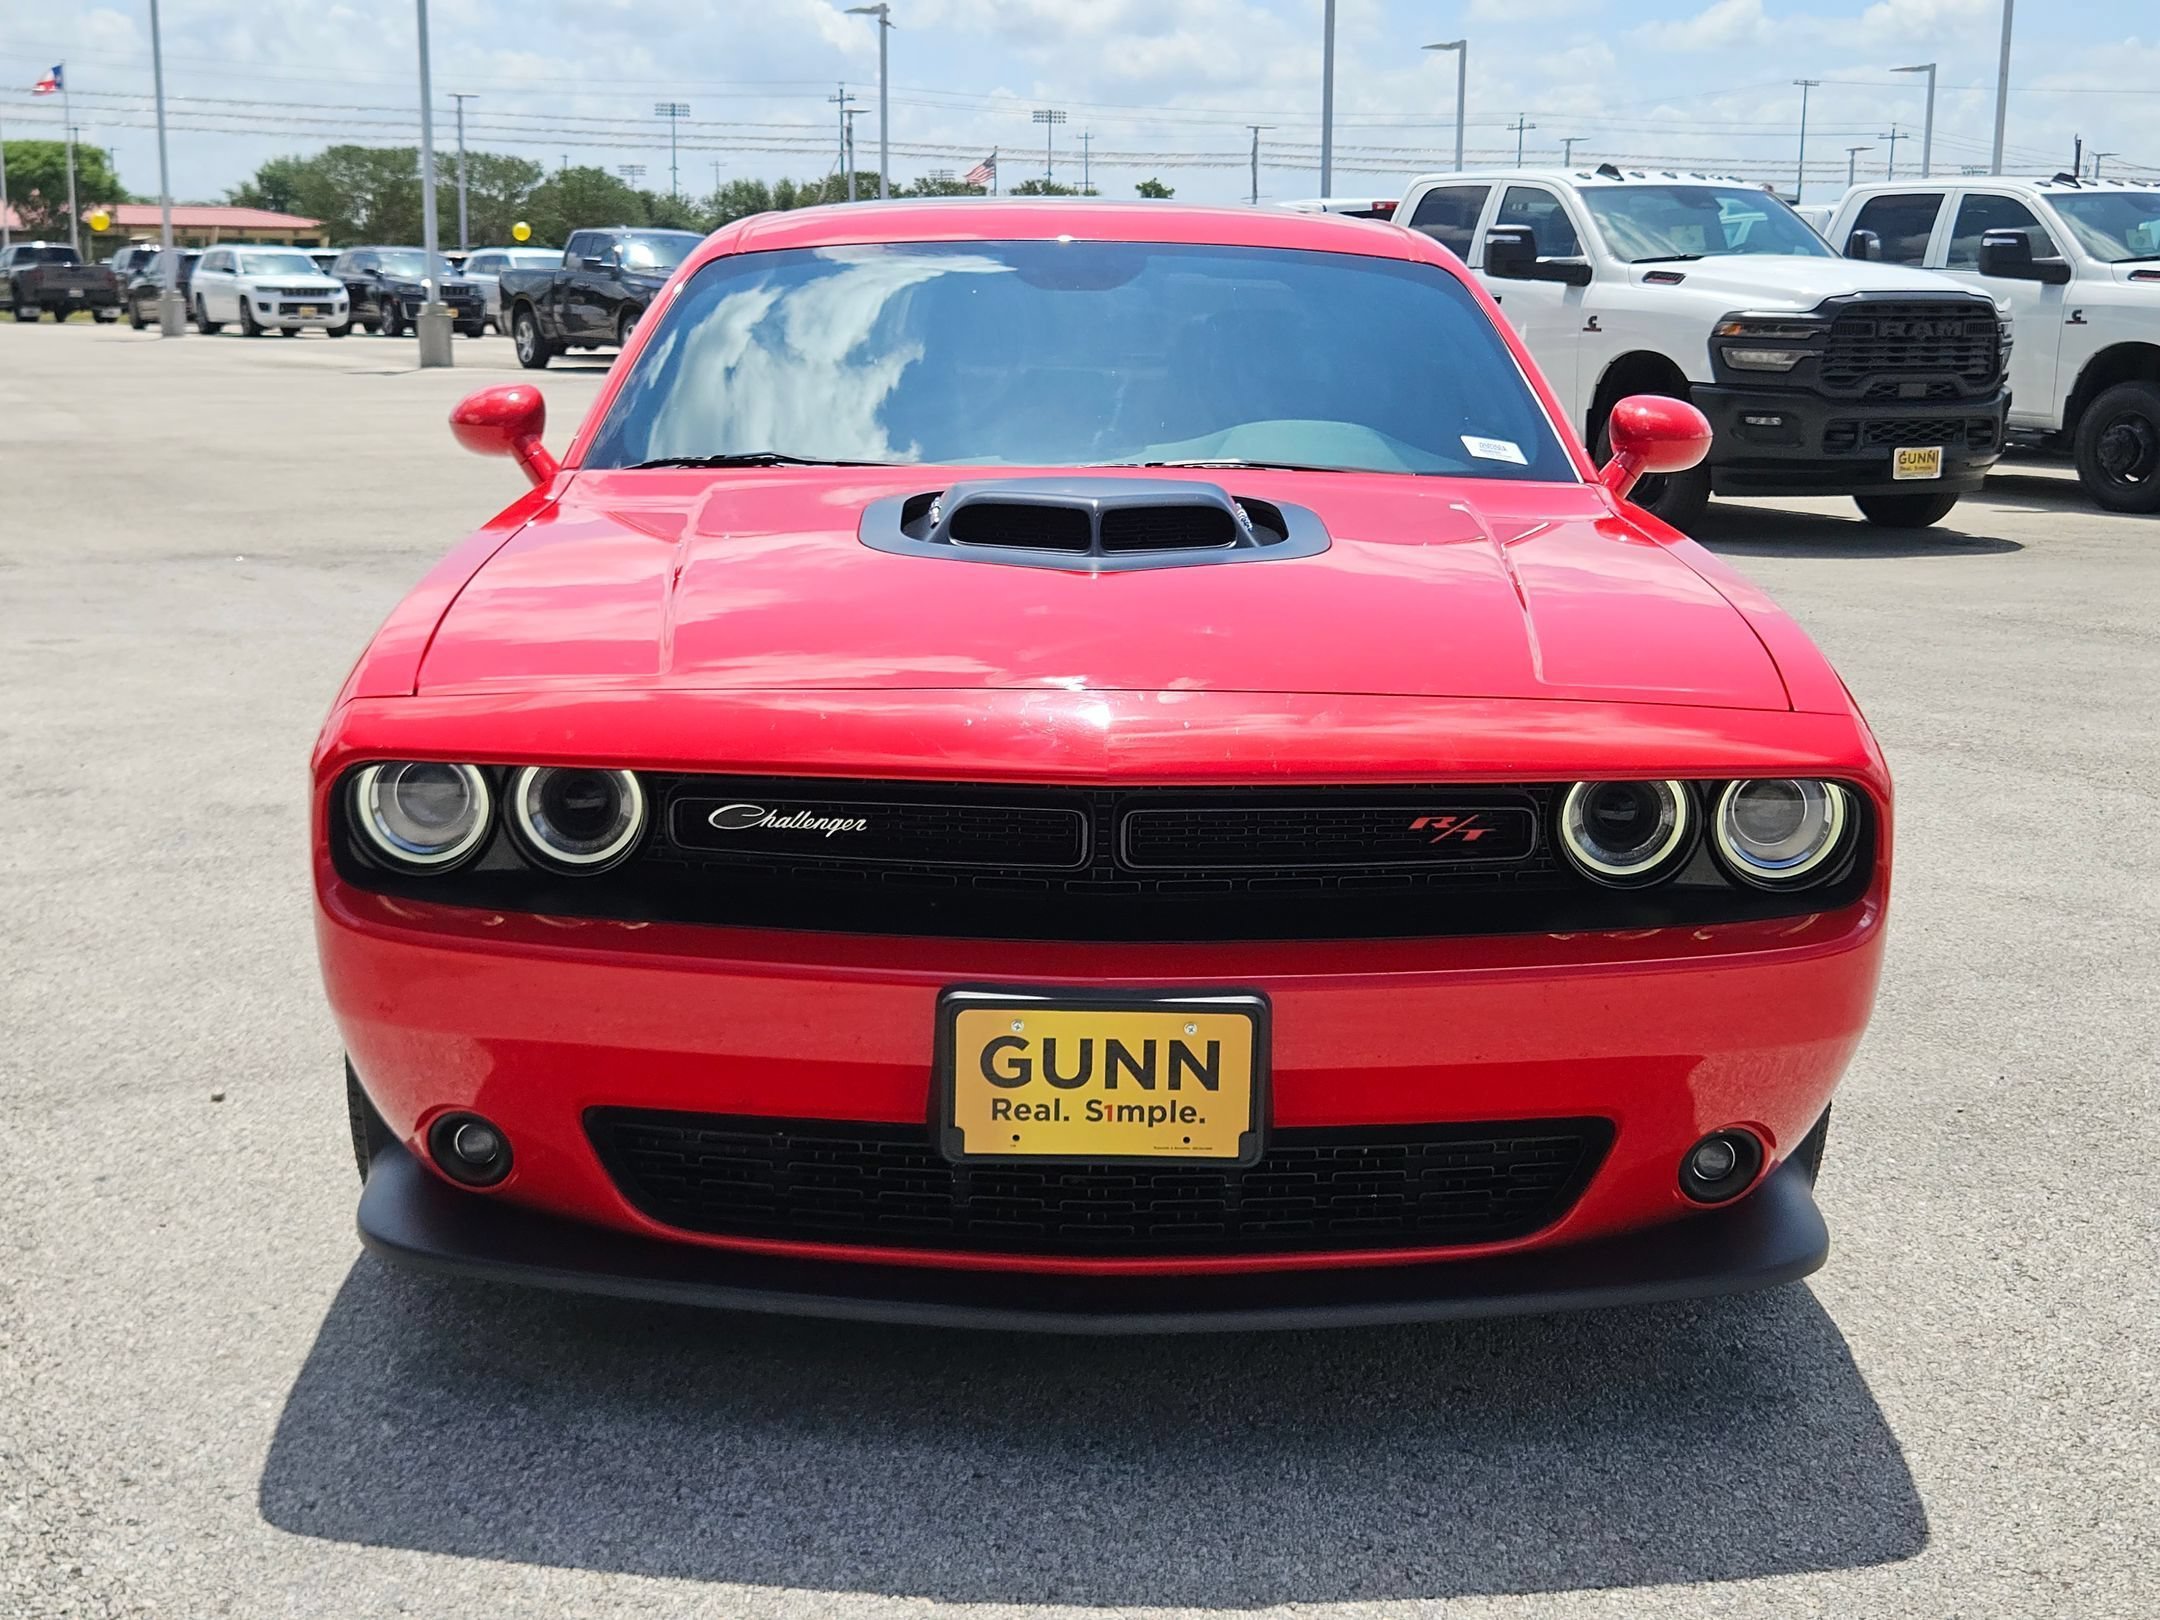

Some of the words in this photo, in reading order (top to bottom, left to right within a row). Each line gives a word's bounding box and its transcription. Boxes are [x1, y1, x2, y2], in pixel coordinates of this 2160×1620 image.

[1878, 320, 1963, 337] RAM
[1898, 451, 1936, 464] GUNN
[708, 803, 867, 838] Challenger
[1408, 814, 1496, 844] R/T
[980, 1035, 1220, 1091] GUNN
[991, 1097, 1070, 1122] Real.
